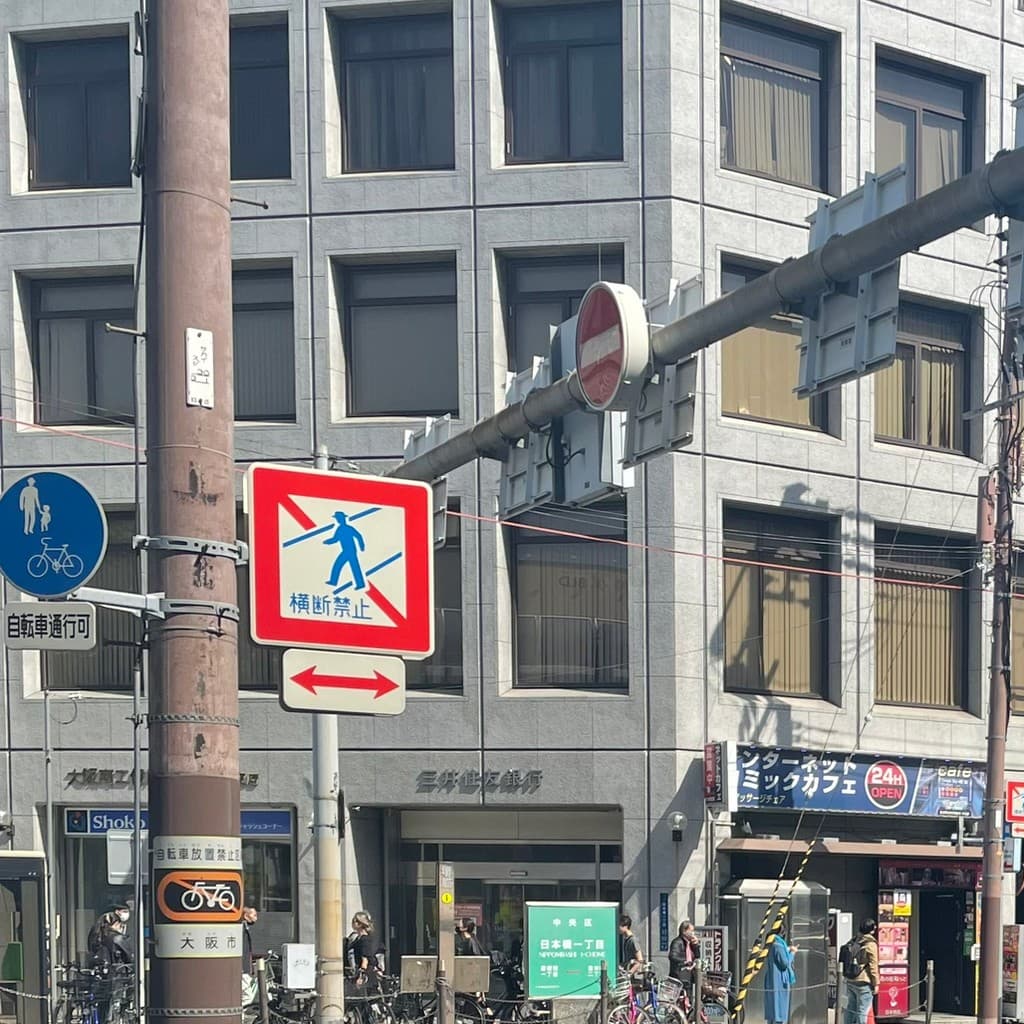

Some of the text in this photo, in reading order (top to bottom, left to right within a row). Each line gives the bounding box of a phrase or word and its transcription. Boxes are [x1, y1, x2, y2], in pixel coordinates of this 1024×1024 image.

[289, 593, 373, 621] 横断禁止
[7, 614, 90, 640] 自転車通行可
[871, 766, 903, 786] 24H
[871, 787, 903, 799] OPEN
[93, 814, 146, 830] Shoko
[181, 936, 237, 950] 大阪市
